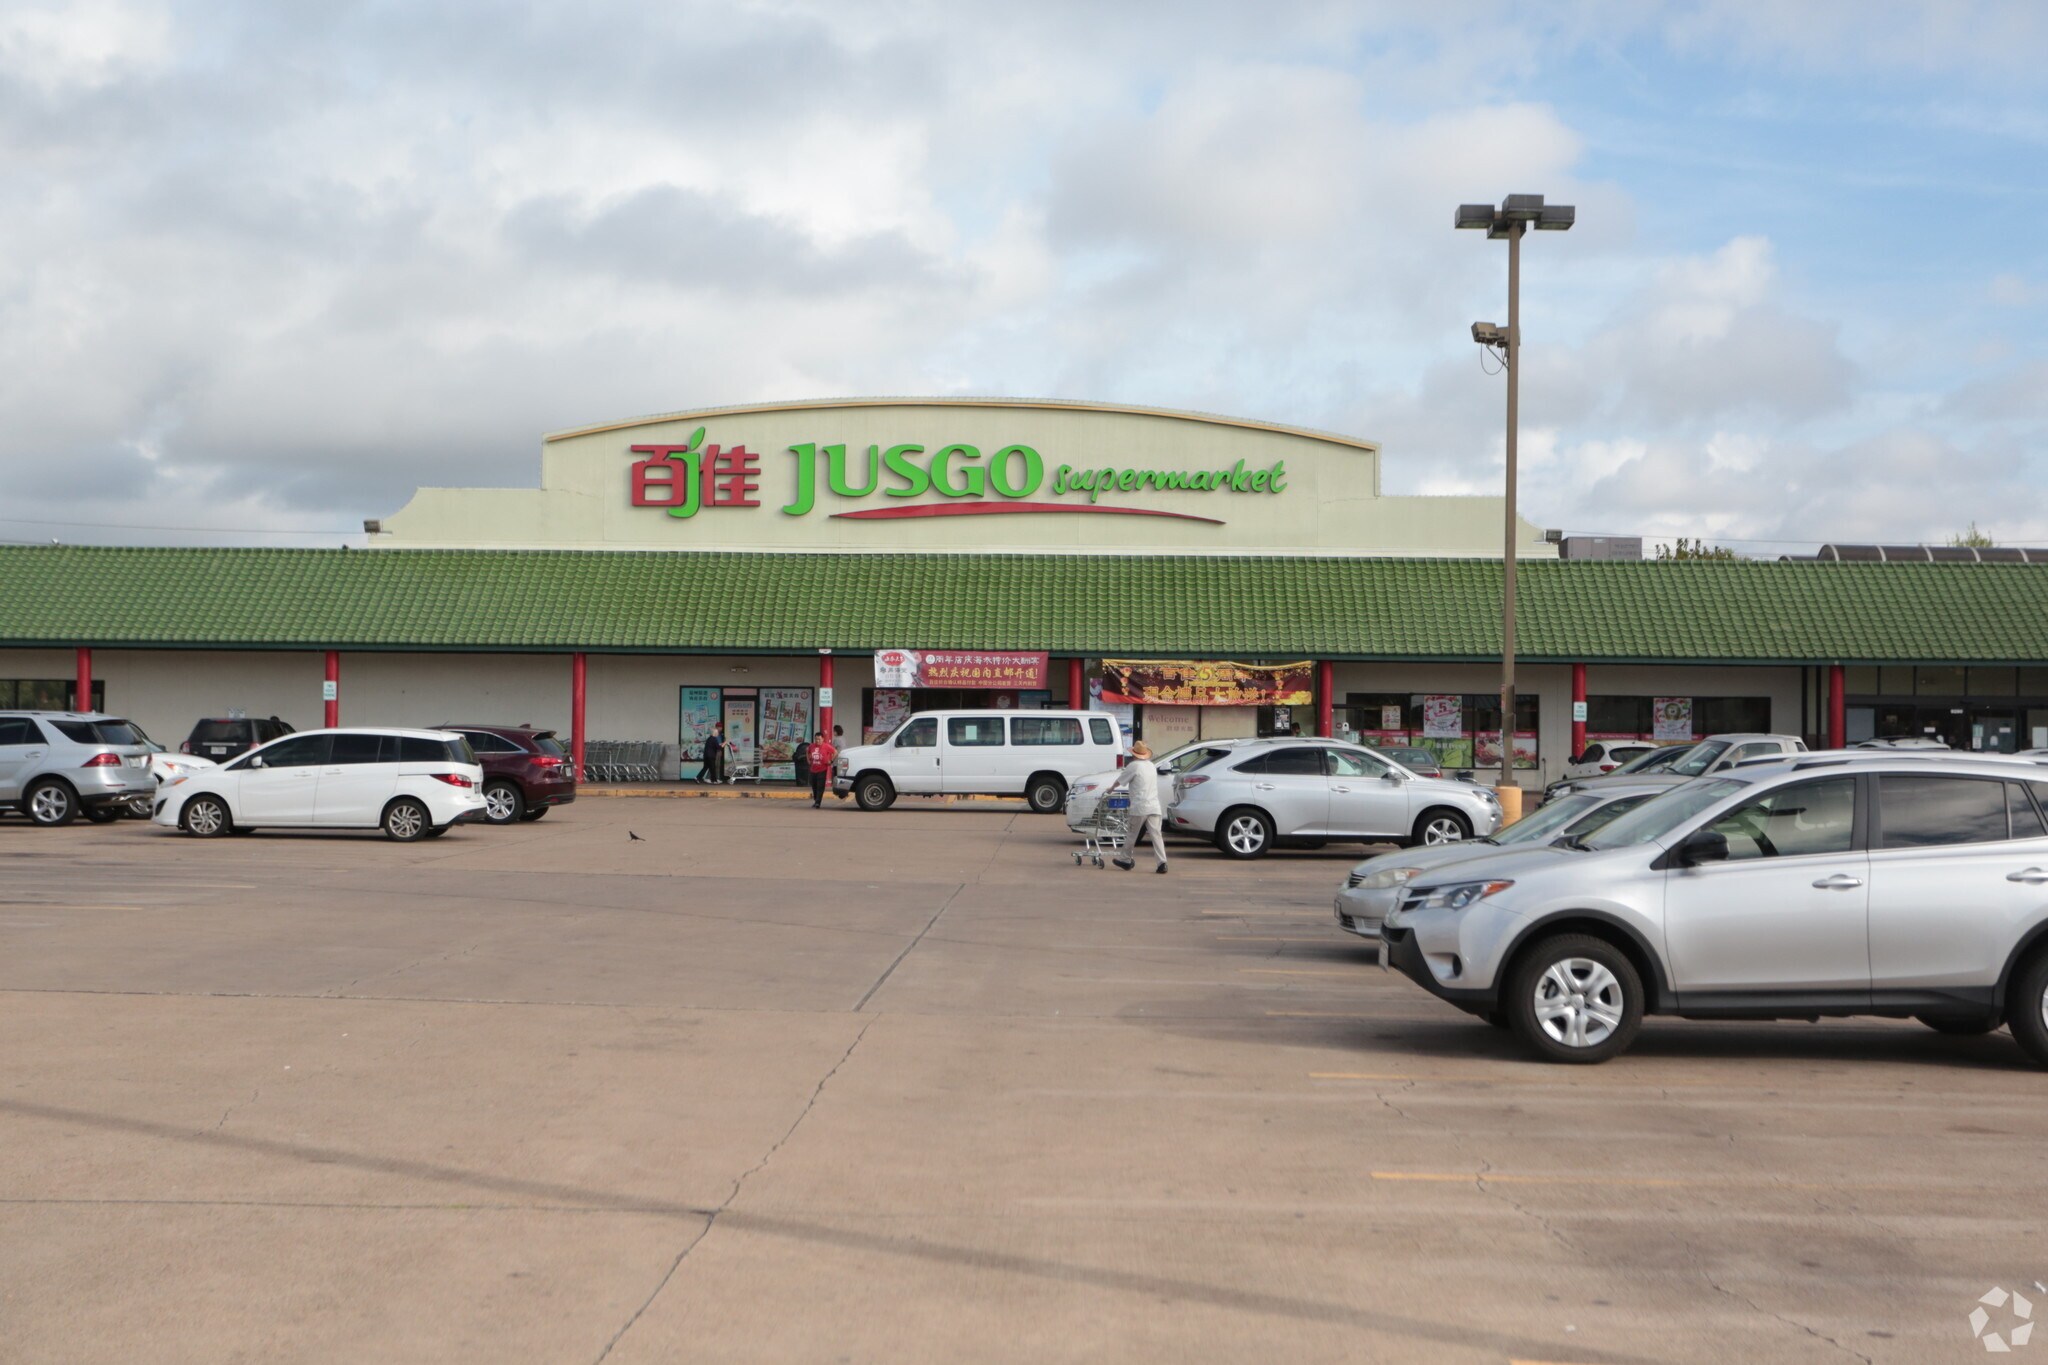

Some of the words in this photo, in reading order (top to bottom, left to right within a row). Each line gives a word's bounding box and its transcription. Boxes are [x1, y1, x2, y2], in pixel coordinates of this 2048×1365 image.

[783, 444, 1043, 517] JUSGO
[1053, 460, 1287, 502] supermarket
[1148, 714, 1189, 723] Welcome
